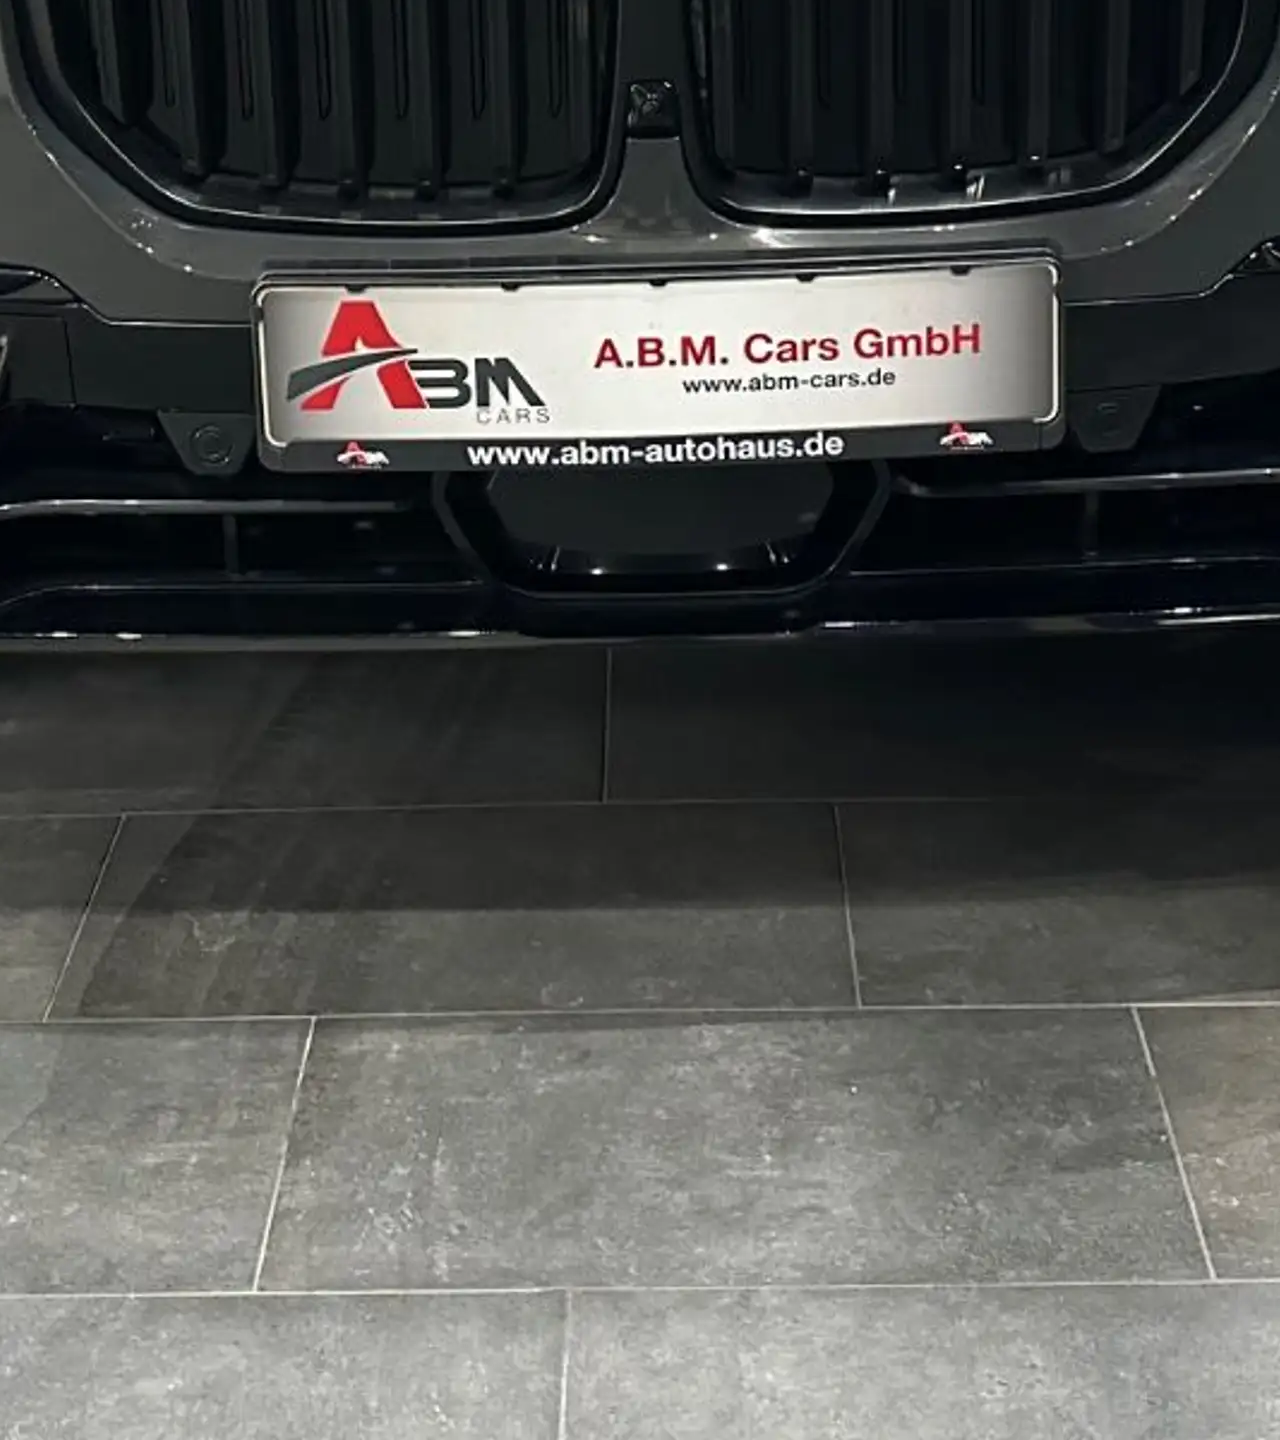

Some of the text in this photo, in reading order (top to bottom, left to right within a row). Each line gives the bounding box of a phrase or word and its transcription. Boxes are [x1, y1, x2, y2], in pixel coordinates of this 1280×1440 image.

[287, 300, 546, 410] ABM
[593, 322, 982, 369] A.B.M. Cars GmbH
[682, 367, 897, 395] www.abm-cars.de
[475, 407, 551, 425] CARS
[466, 431, 845, 466] www.abm-autohaus.de
